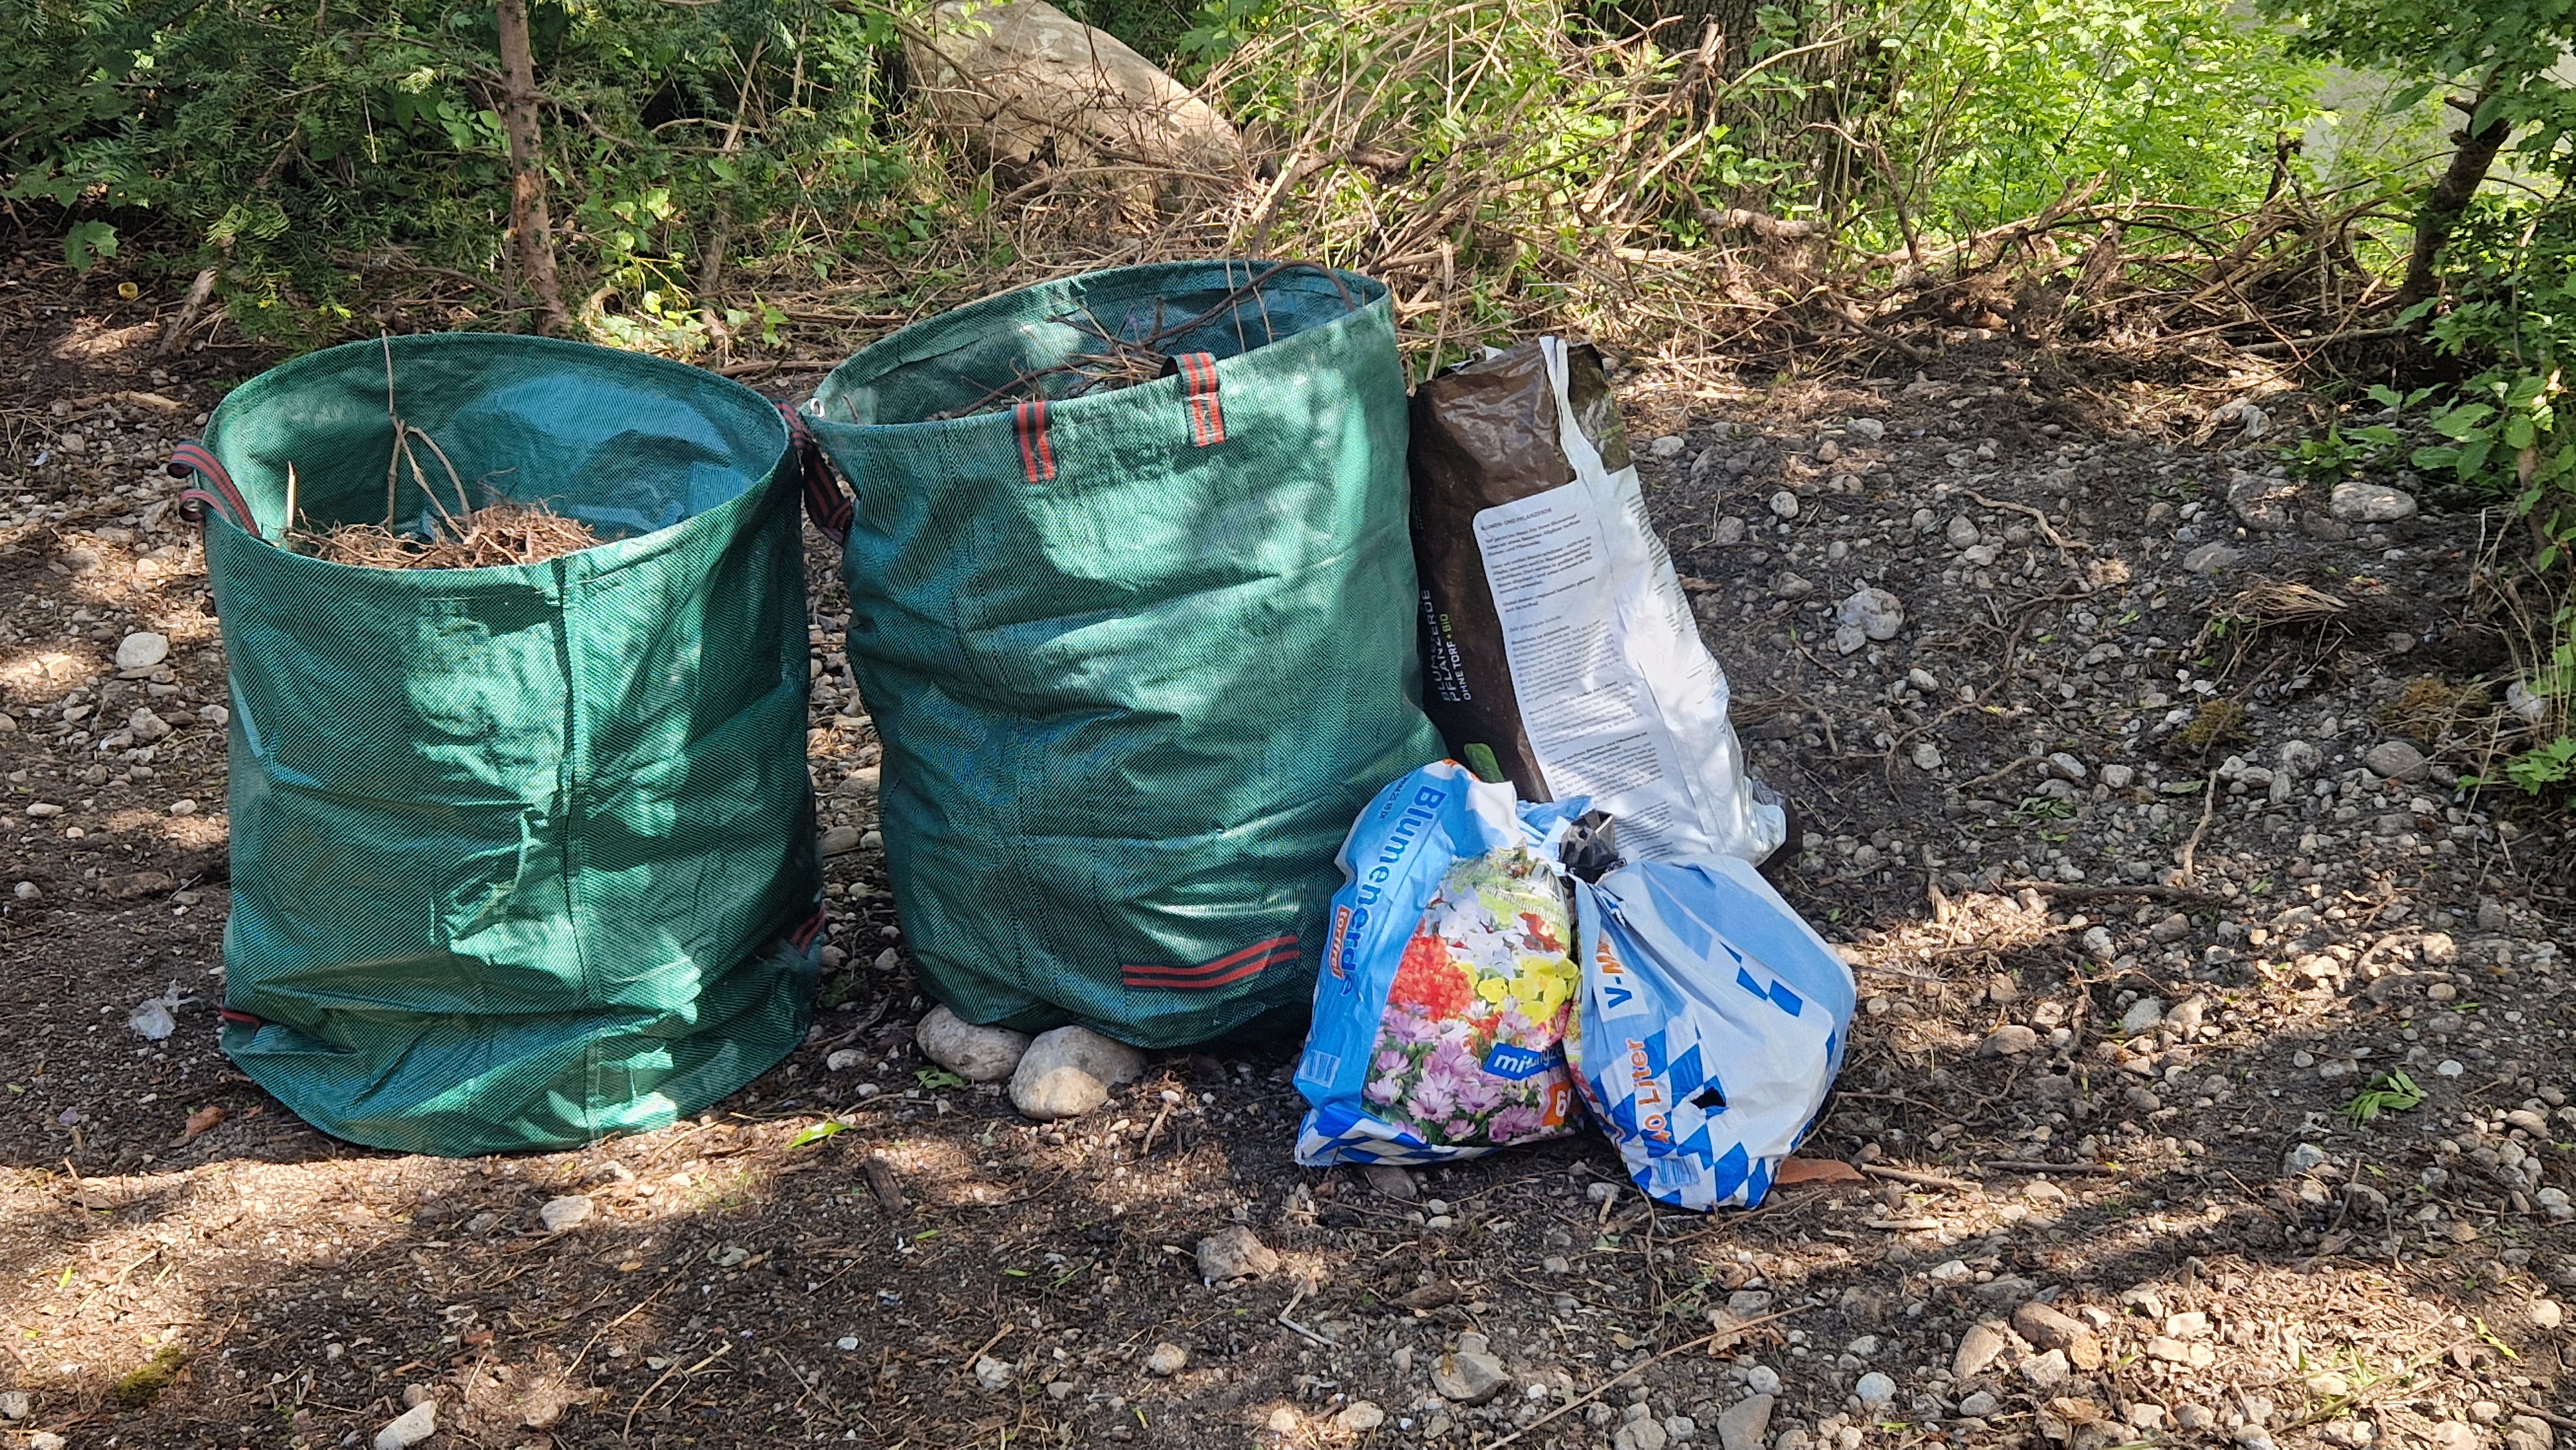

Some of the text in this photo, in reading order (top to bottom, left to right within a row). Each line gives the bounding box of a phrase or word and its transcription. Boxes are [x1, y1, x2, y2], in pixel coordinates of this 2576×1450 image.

[1438, 612, 1452, 632] BIO
[1445, 639, 1461, 670] TORF
[1454, 669, 1472, 701] OHNE
[1340, 785, 1448, 995] Blumenerde
[1626, 1038, 1661, 1106] Liter
